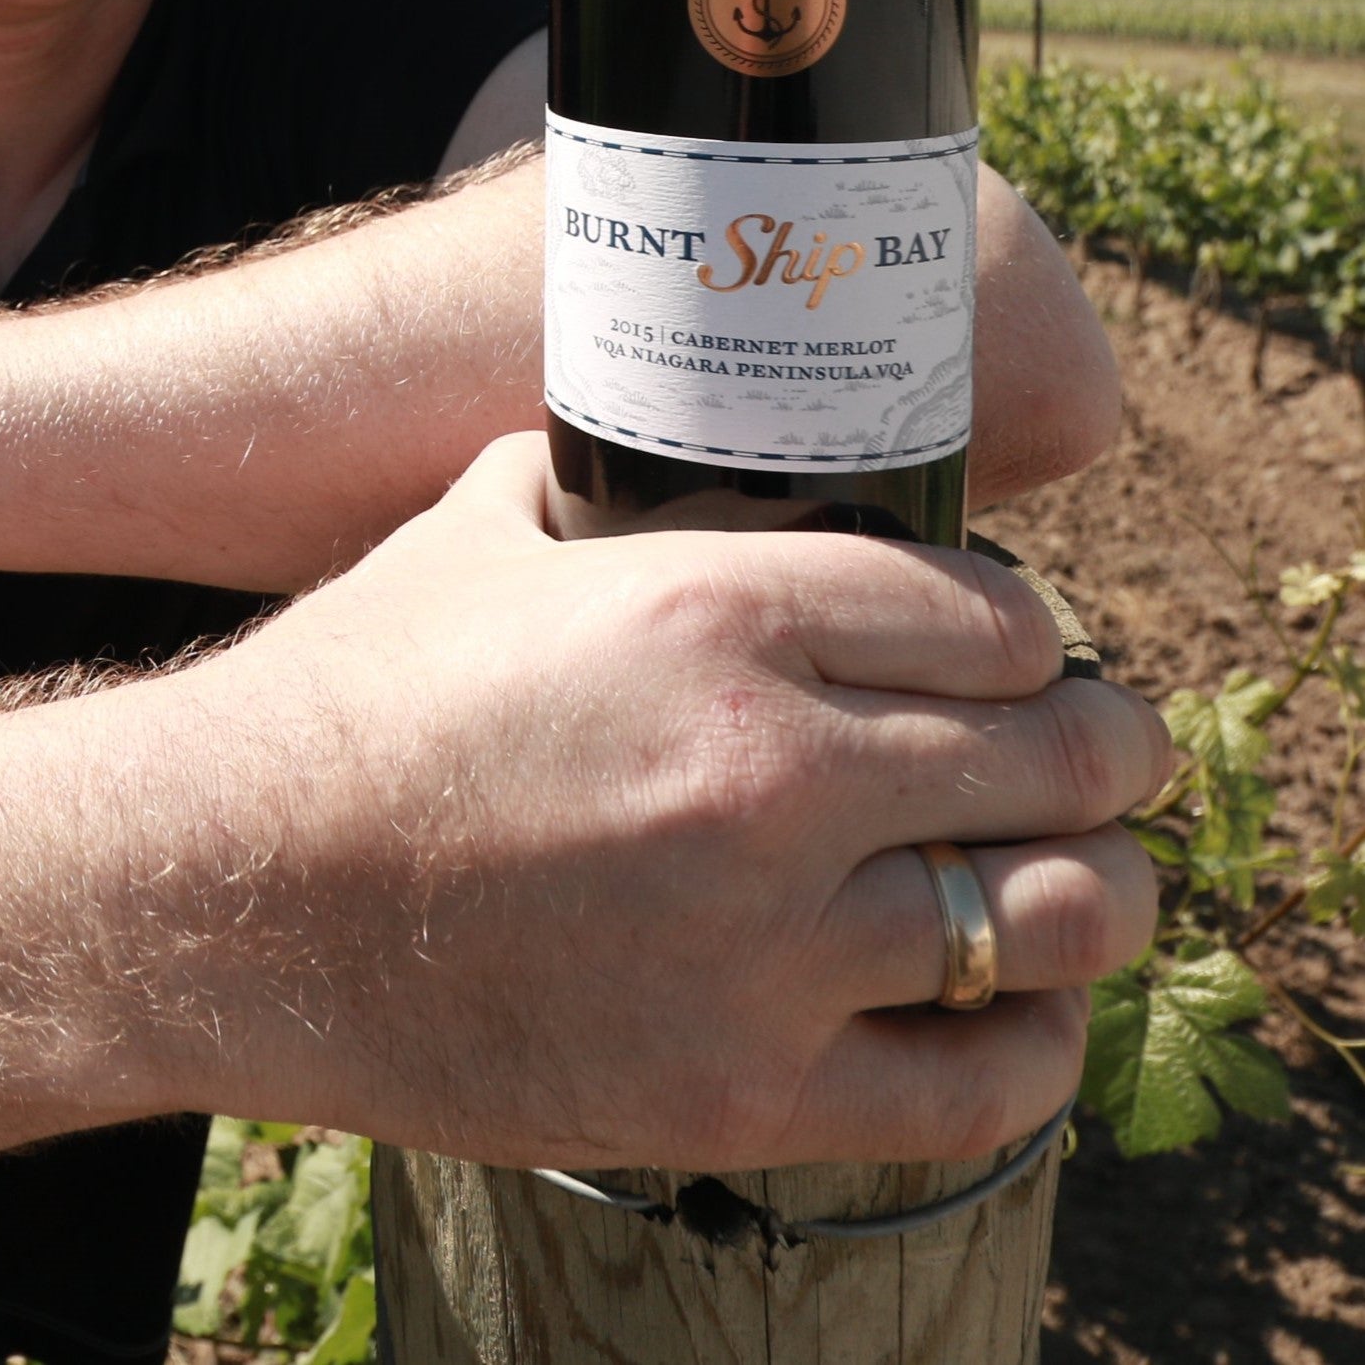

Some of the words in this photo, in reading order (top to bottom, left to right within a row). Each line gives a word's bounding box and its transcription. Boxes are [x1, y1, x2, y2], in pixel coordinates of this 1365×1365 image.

[564, 206, 706, 262] BURNT
[696, 213, 867, 310] Ship
[874, 228, 952, 268] BAY
[593, 335, 627, 361] VQA
[630, 344, 731, 376] NIAGARA
[735, 361, 873, 381] PENINSULA
[874, 360, 915, 382] VQA
[609, 317, 654, 343] 2015
[670, 330, 801, 356] CABERNET
[803, 338, 897, 357] MERLOT
